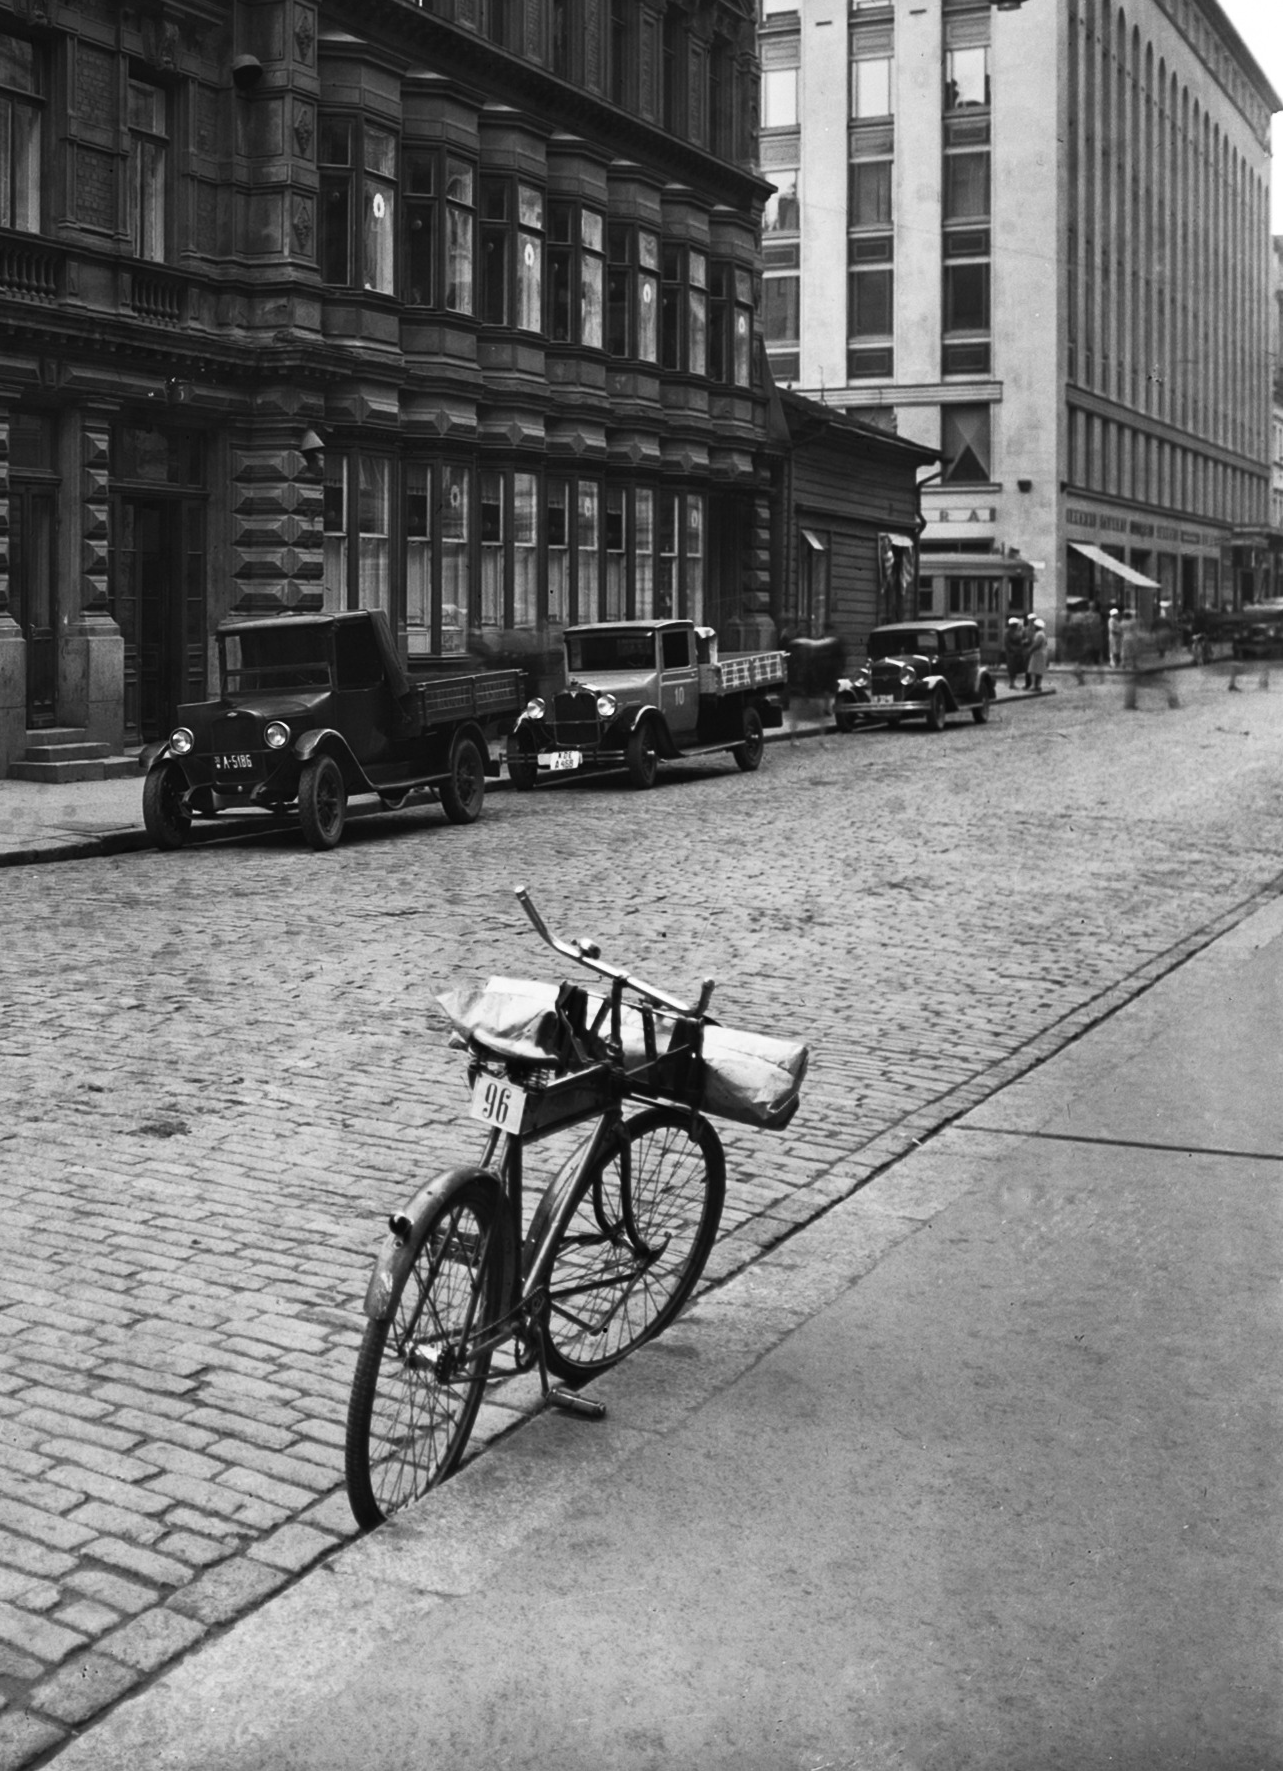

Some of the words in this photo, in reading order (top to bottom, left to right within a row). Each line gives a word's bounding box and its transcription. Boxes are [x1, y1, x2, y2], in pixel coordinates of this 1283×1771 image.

[674, 686, 685, 706] 10
[223, 754, 253, 770] A-5186
[482, 1082, 512, 1124] 96
